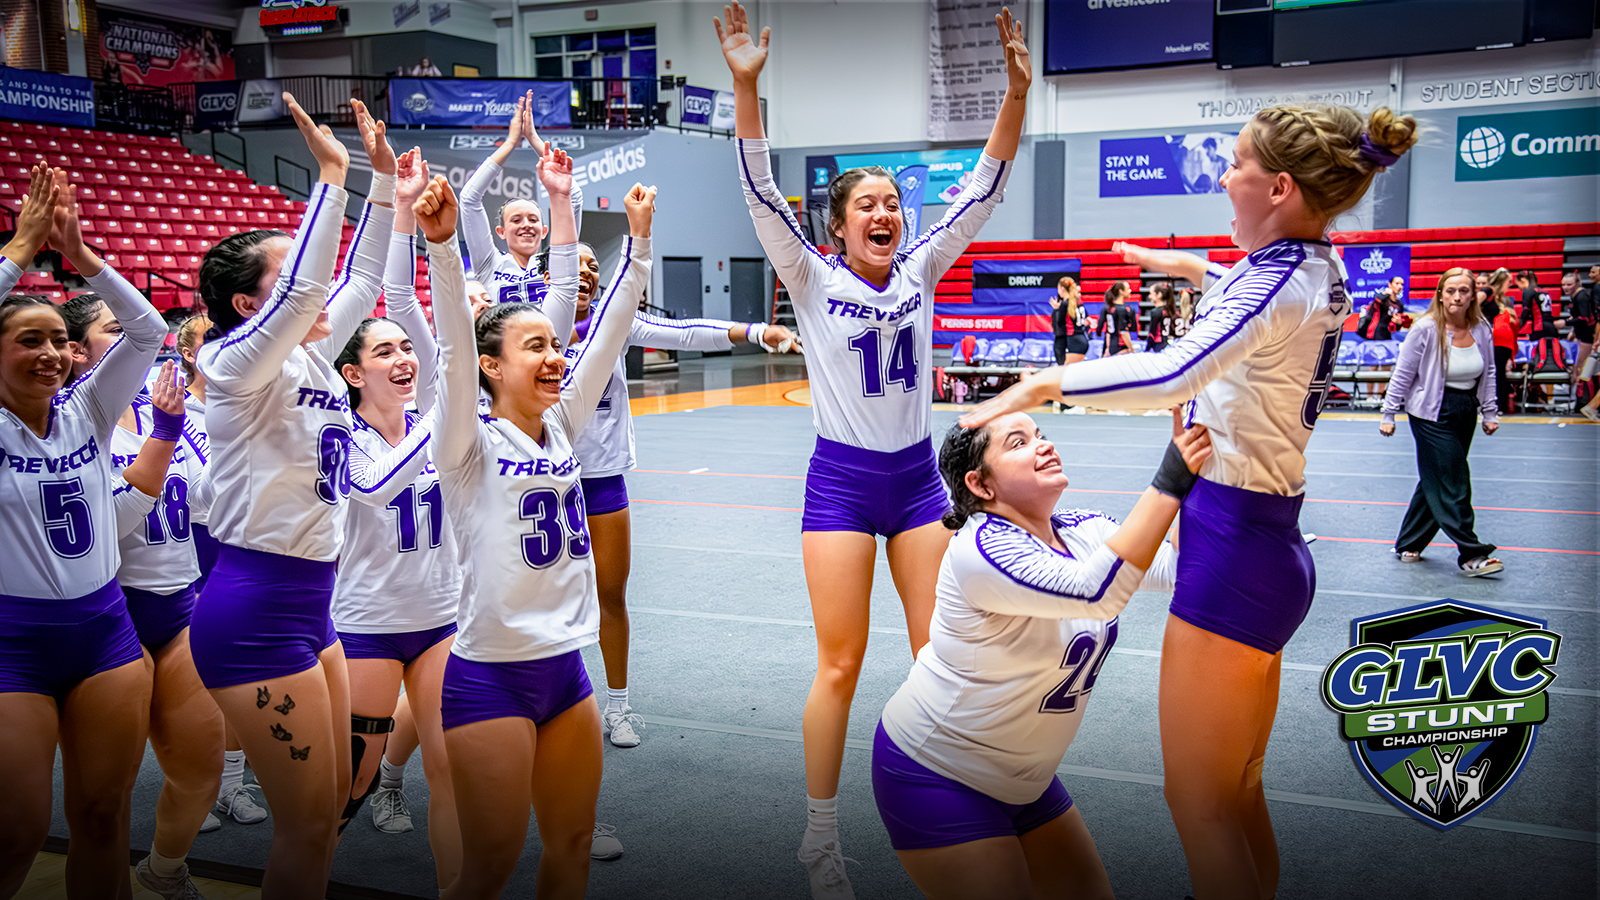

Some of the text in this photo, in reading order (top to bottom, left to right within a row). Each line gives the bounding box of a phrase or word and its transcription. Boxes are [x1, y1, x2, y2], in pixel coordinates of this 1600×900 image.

[112, 26, 174, 45] NATIONAL
[106, 37, 179, 59] CHAMPIONS
[9, 81, 28, 89] AND
[59, 87, 72, 95] TO
[75, 89, 90, 98] THE
[1421, 77, 1523, 102] STUDENT
[449, 99, 517, 116] MAKE IT YOURS
[587, 146, 646, 183] adidas
[1105, 154, 1149, 168] STAY IN
[1105, 167, 1167, 181] THE GAME.
[1008, 275, 1043, 286] DRURY
[827, 292, 922, 322] TREVECCA
[941, 318, 1004, 329] FERRIS STATE
[848, 321, 919, 398] 14
[38, 476, 95, 559] 5
[145, 473, 191, 546] 18
[386, 480, 444, 553] 11
[518, 481, 591, 570] 39
